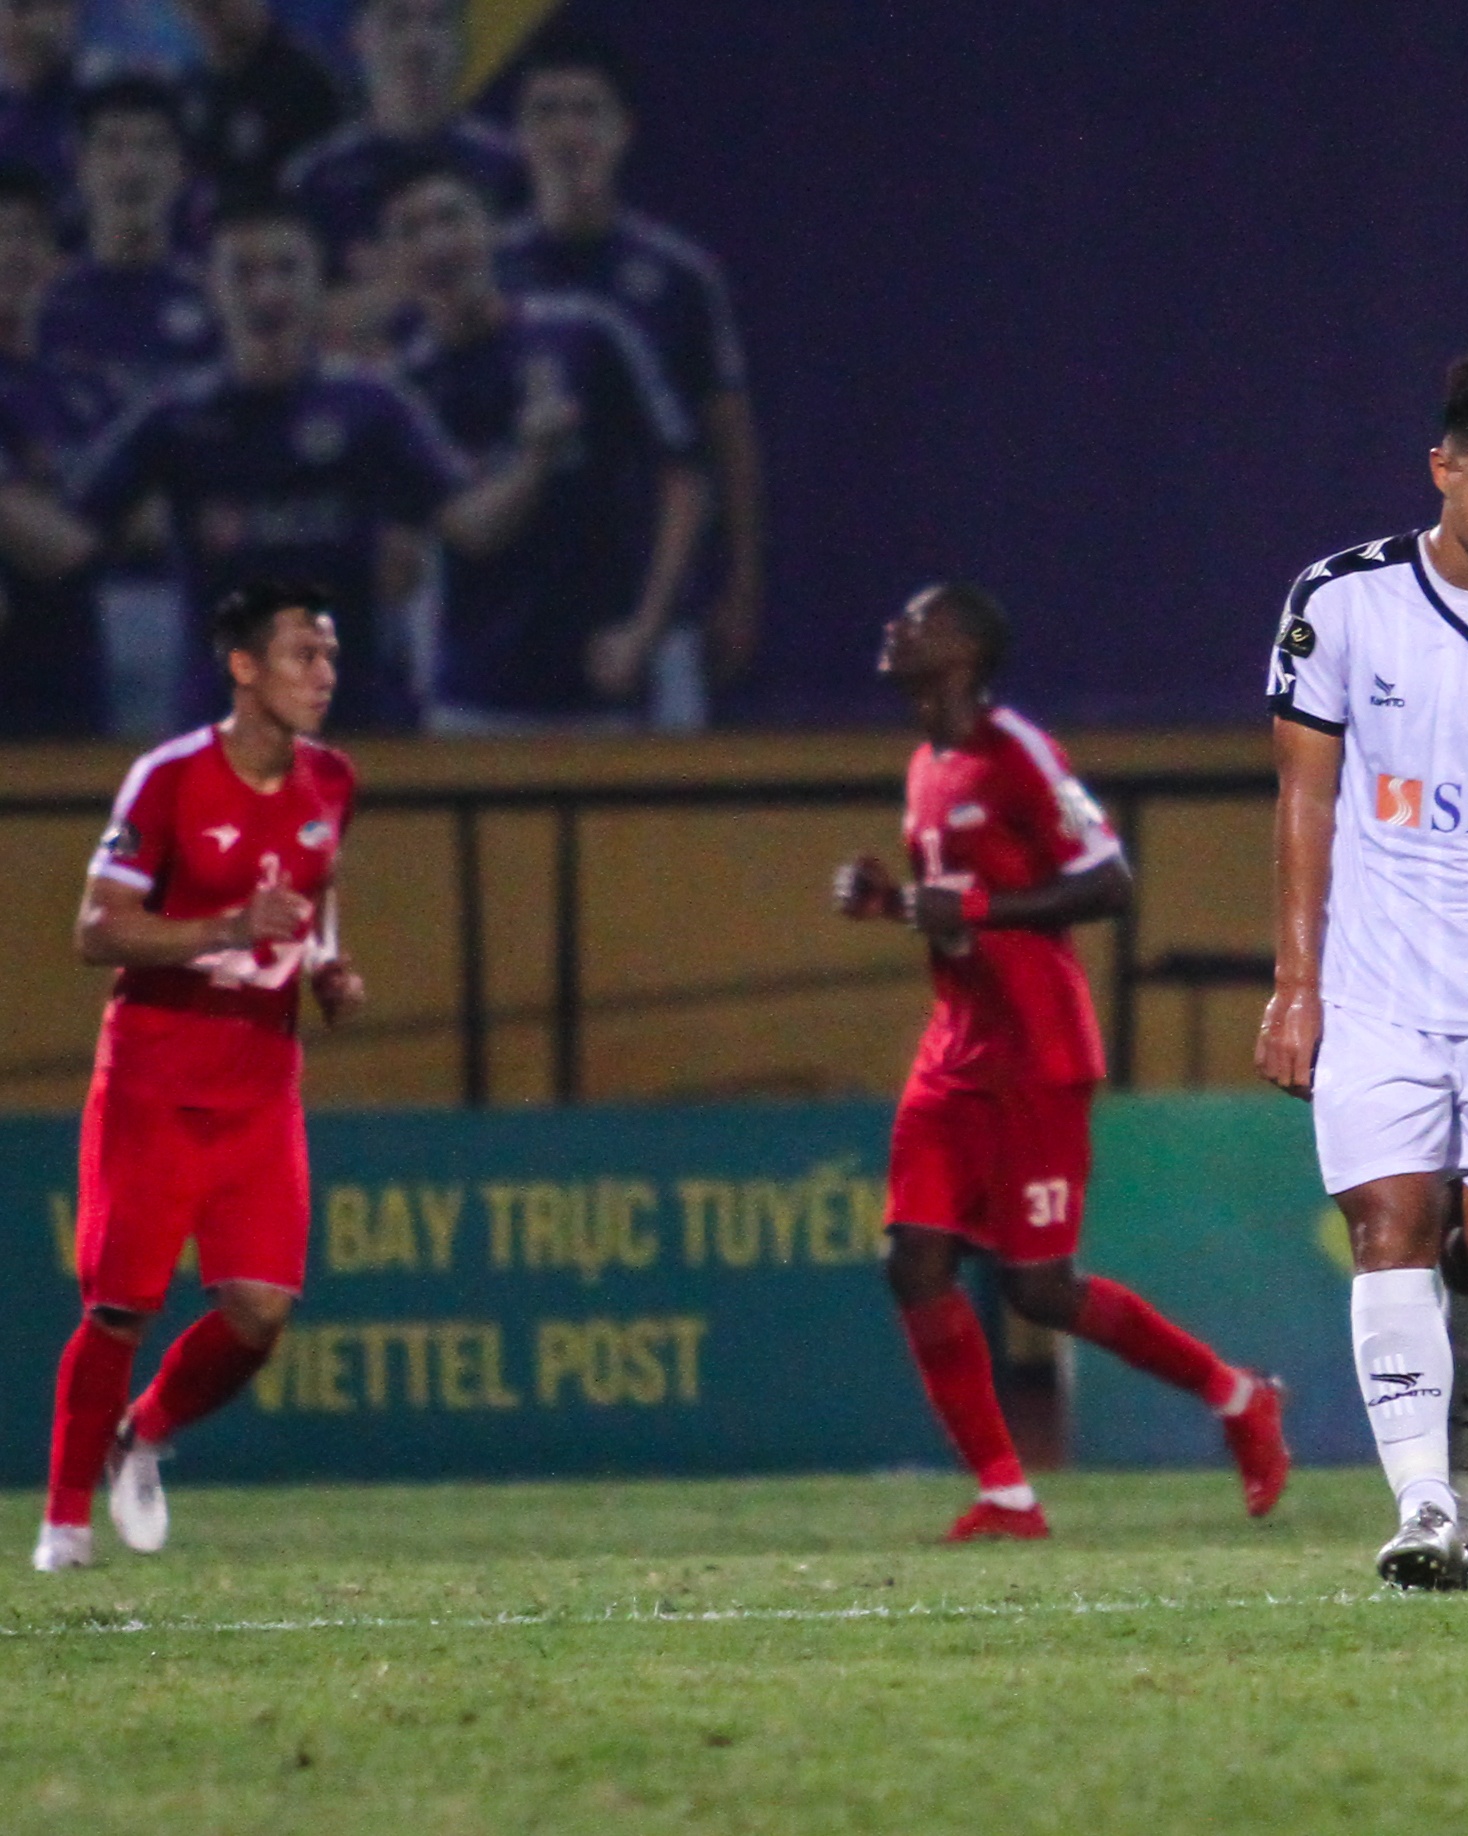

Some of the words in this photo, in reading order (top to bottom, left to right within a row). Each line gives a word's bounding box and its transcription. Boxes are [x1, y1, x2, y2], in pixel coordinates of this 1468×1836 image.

[325, 1184, 465, 1273] BAY
[1022, 1177, 1069, 1228] 37
[536, 1316, 708, 1408] POST
